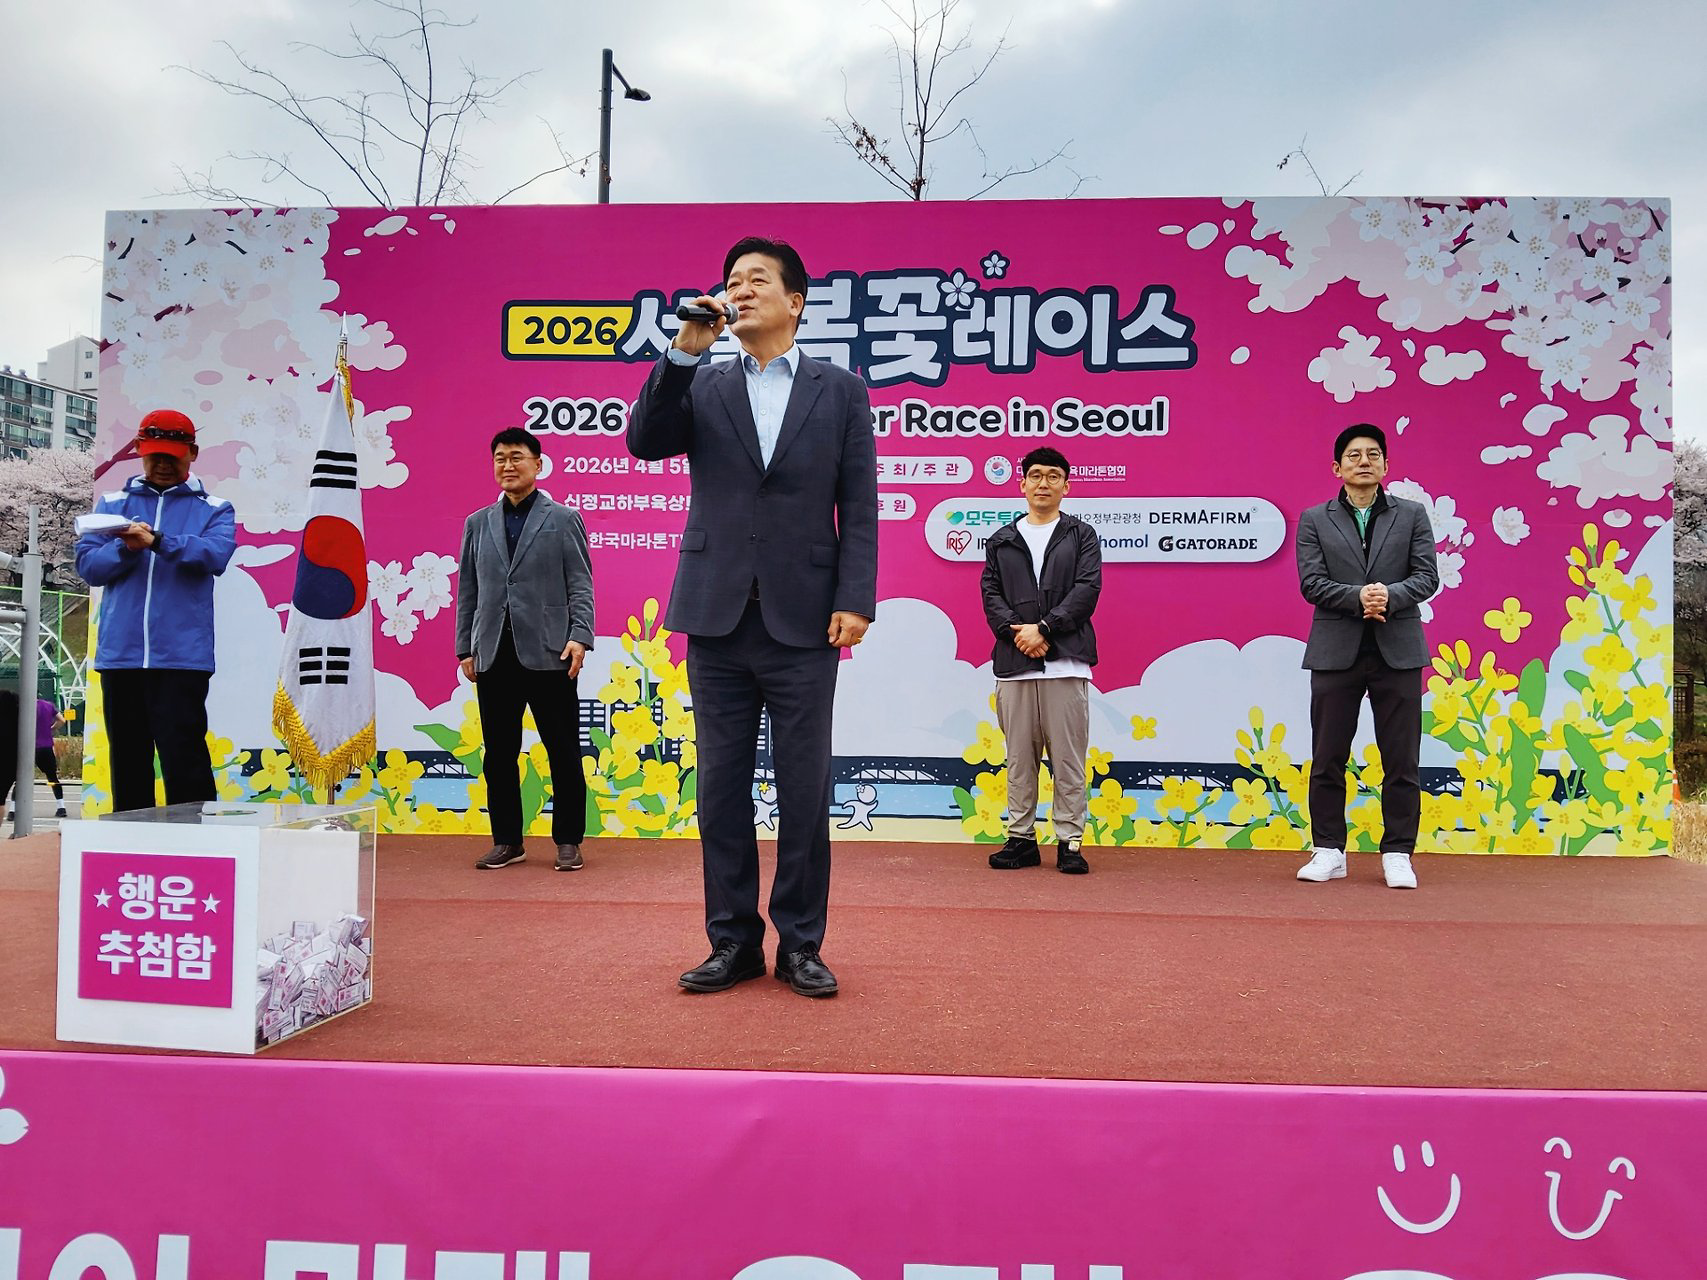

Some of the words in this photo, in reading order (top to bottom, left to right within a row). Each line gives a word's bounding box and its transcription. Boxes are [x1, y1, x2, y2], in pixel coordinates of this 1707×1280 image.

[523, 316, 618, 345] 2026
[529, 401, 623, 431] 2026
[905, 403, 1001, 432] Race
[1013, 402, 1045, 432] in
[1056, 401, 1165, 432] Seoul
[564, 457, 629, 474] 2026년
[1150, 509, 1250, 524] DERMAFIRM
[1098, 534, 1148, 548] homol
[1176, 539, 1257, 550] GATORADE
[118, 872, 195, 921] 행운
[97, 930, 216, 980] 추첨함
